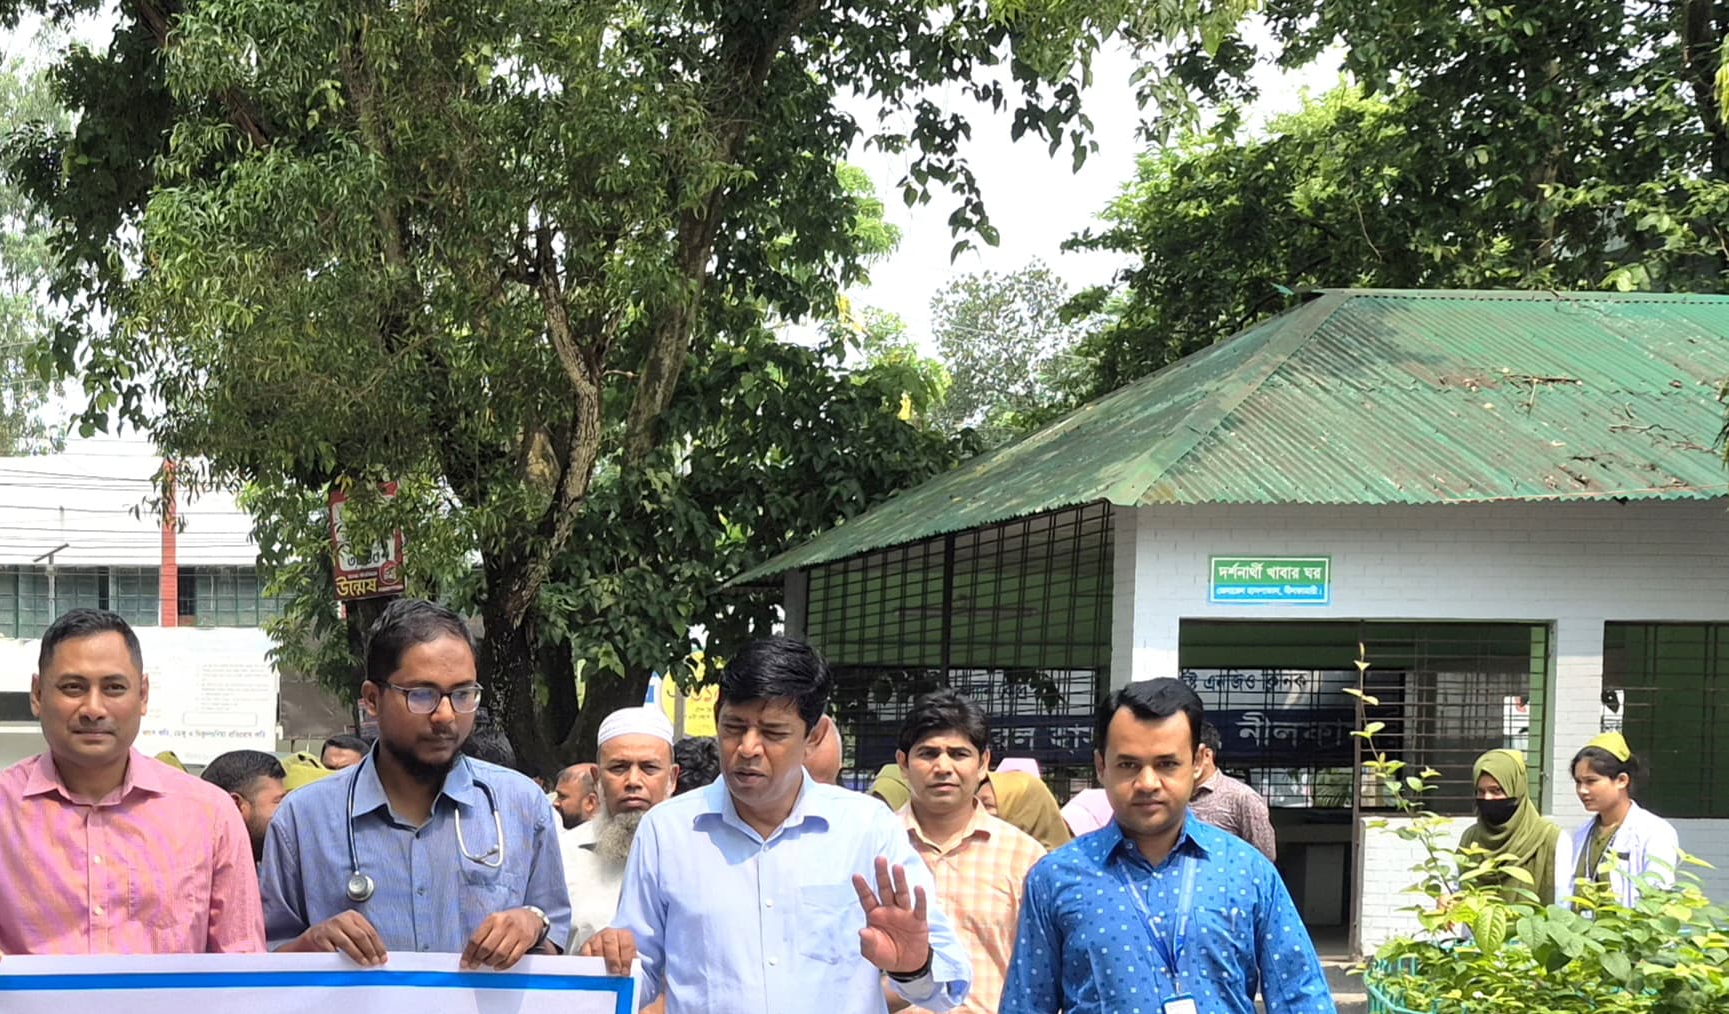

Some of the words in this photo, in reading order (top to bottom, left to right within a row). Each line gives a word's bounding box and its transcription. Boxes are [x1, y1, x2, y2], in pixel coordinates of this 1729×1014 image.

[1266, 566, 1301, 580] খাবার
[1303, 566, 1323, 580] ঘর
[335, 576, 378, 597] উন্মেষ
